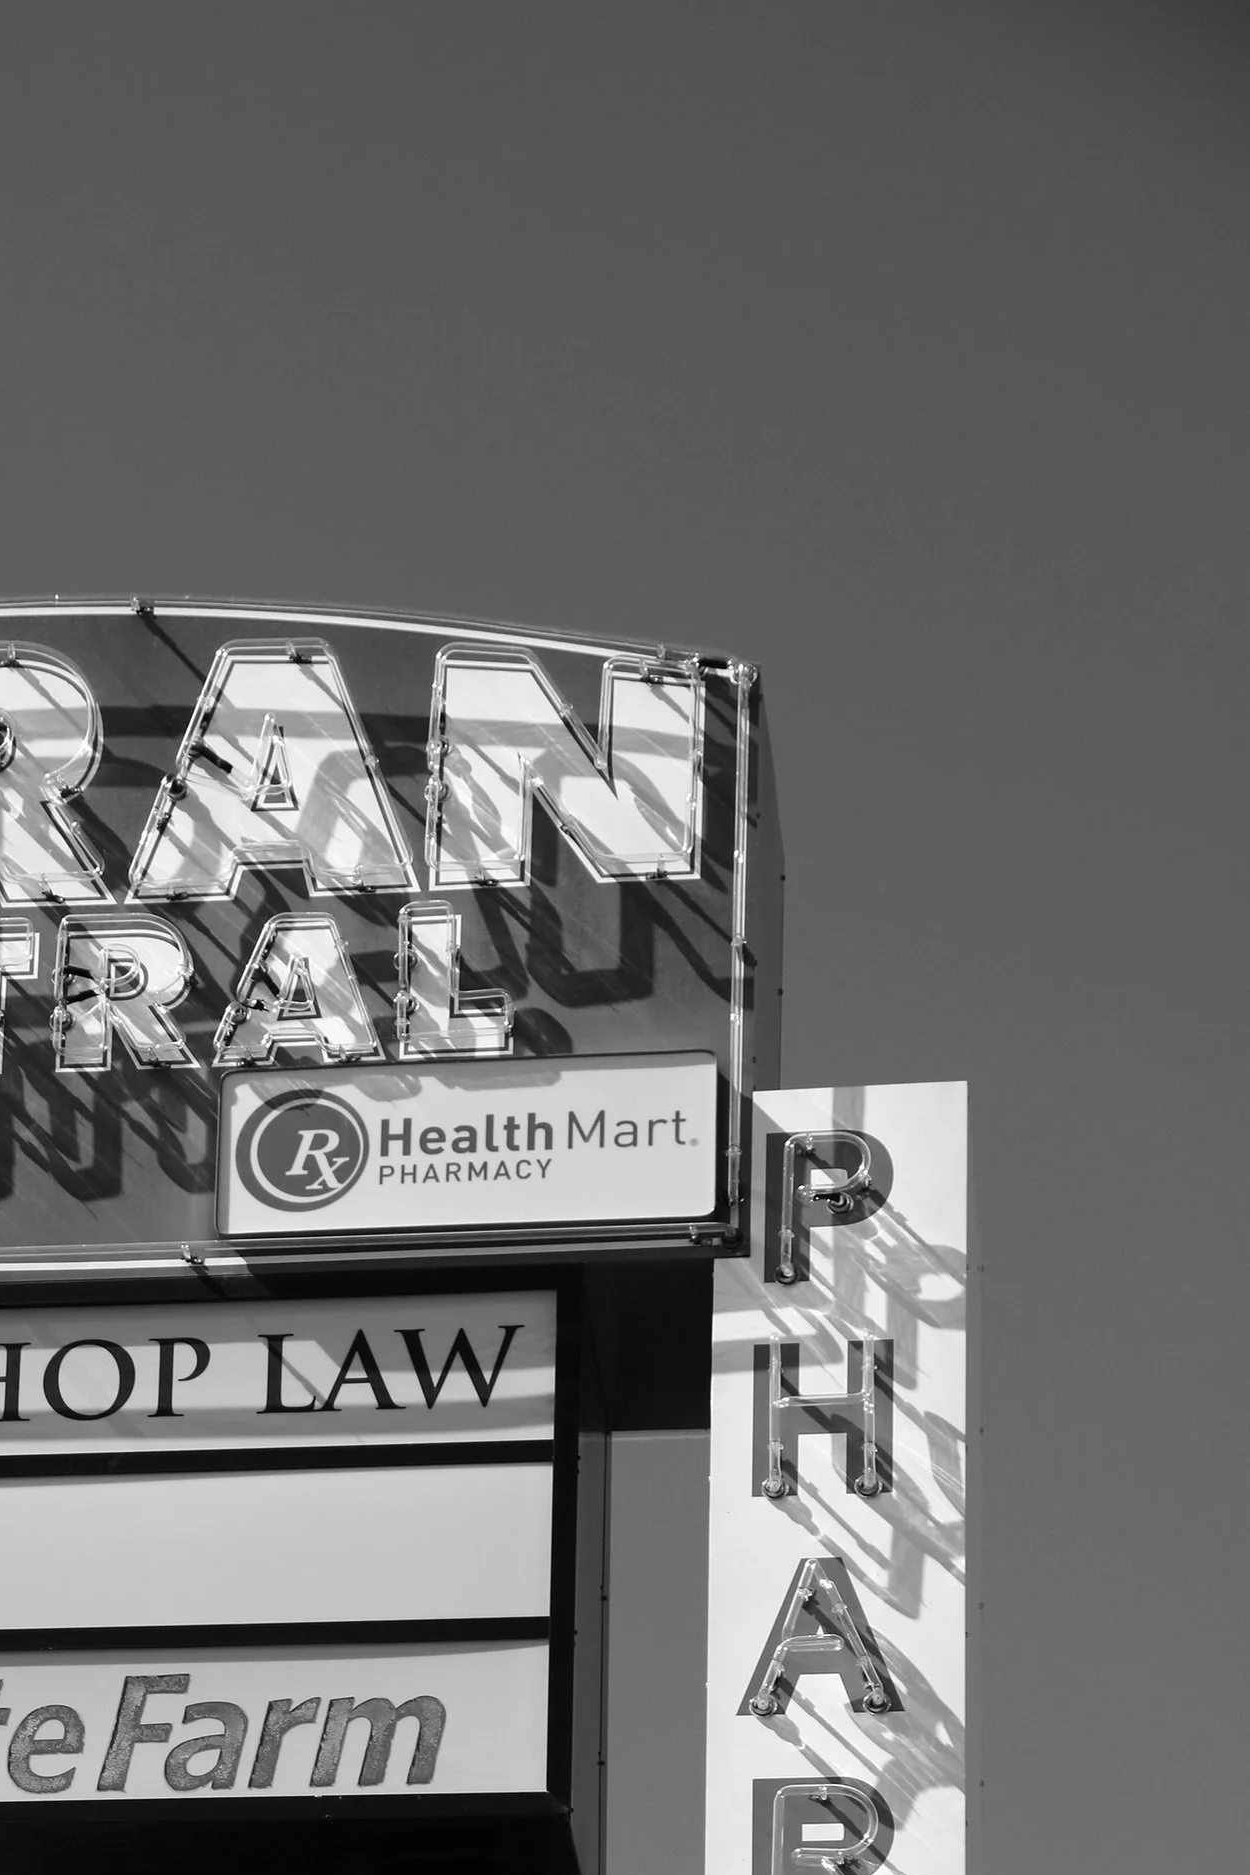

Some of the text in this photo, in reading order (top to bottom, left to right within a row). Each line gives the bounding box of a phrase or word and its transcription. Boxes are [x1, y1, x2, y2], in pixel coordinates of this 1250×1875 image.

[380, 1113, 554, 1156] Health
[378, 1158, 553, 1185] PHARMACY
[256, 1324, 525, 1414] LAW
